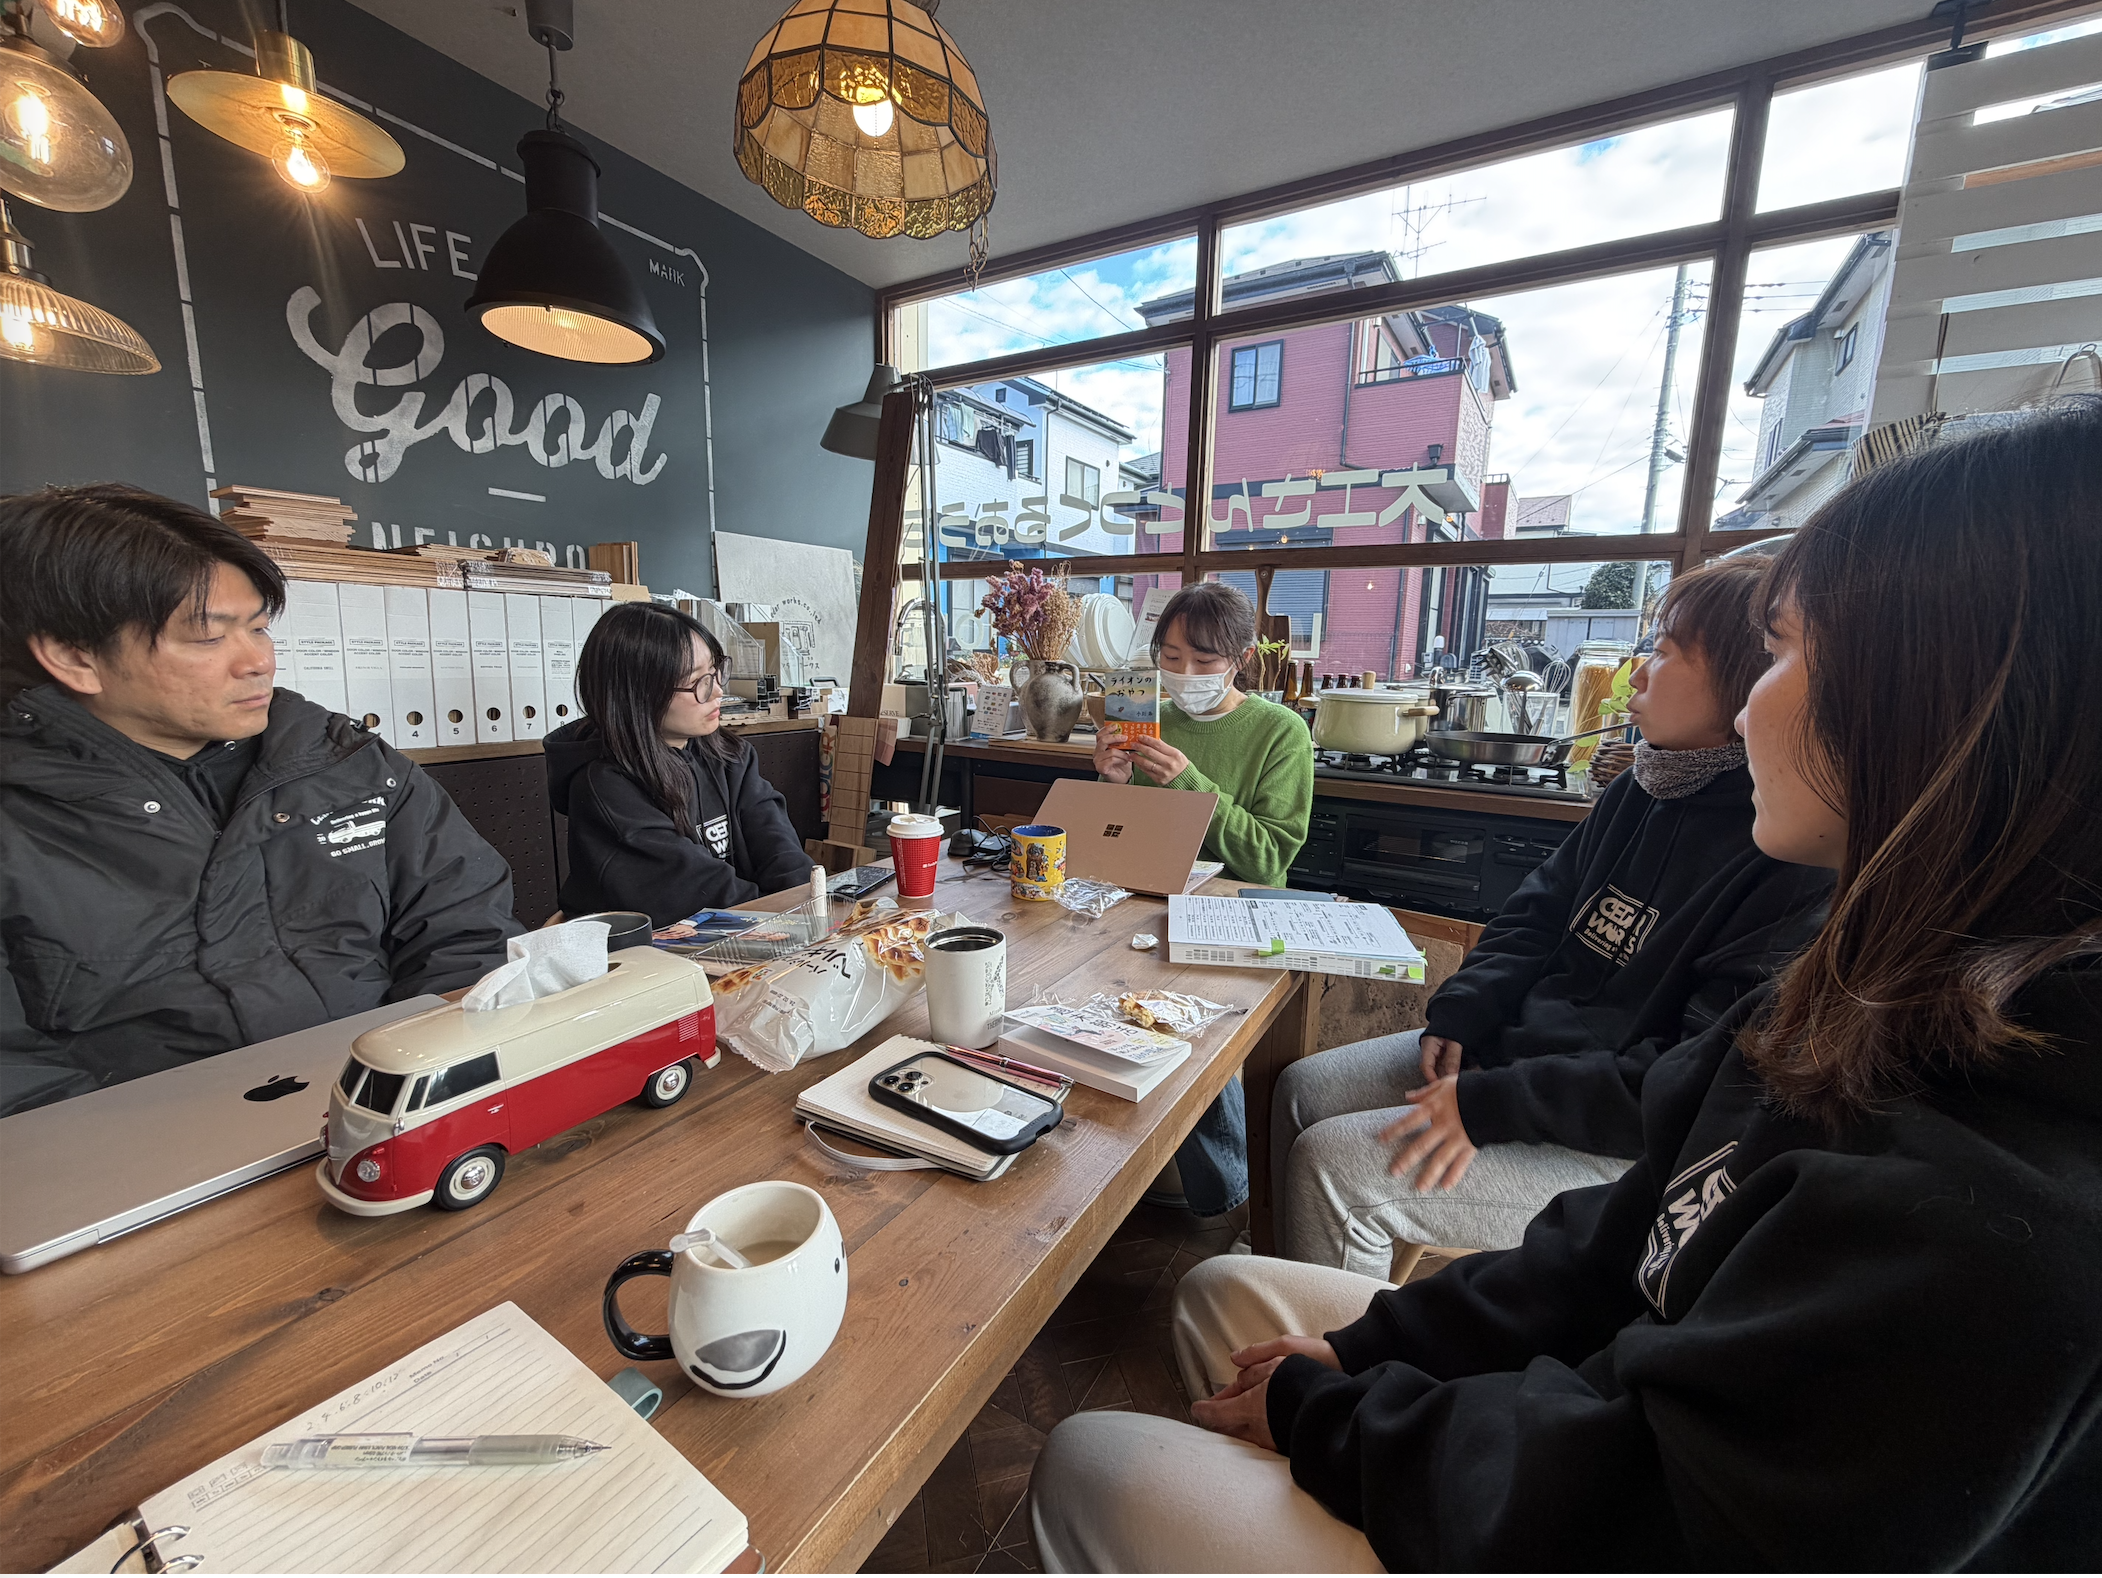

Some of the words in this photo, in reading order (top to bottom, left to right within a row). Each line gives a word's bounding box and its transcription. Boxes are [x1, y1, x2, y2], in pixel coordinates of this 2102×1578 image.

[355, 217, 479, 282] LIFE
[649, 258, 686, 287] MARK
[286, 285, 668, 485] Good
[1110, 676, 1152, 687] ライオンの
[1117, 688, 1145, 698] おやつ
[412, 730, 419, 738] 4
[330, 849, 343, 857] GO
[1587, 910, 1637, 955] WORS
[409, 1362, 433, 1379] Memo
[413, 1370, 433, 1384] Date
